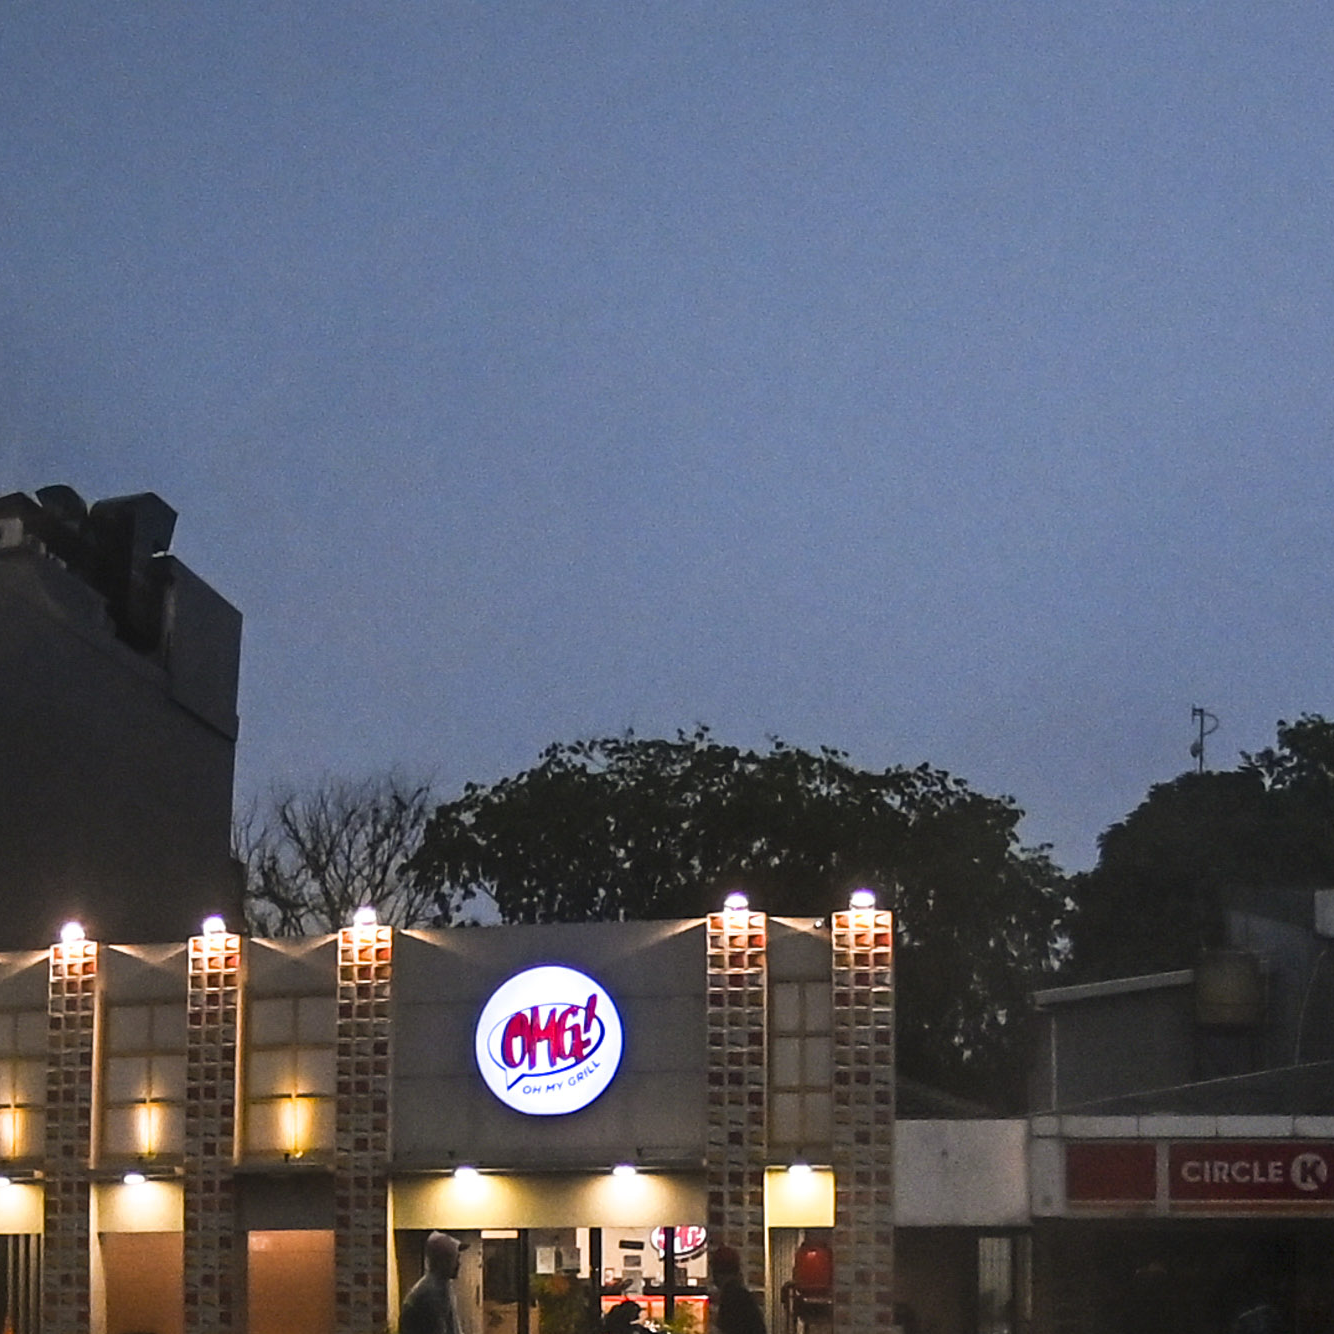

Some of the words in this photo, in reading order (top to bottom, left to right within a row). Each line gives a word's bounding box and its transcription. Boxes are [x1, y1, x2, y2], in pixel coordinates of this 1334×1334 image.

[501, 993, 597, 1071] OMG!
[522, 1085, 542, 1095] OH
[546, 1080, 564, 1093] MY
[568, 1060, 601, 1087] GRILL
[1180, 1160, 1284, 1184] CIRCLE
[1294, 1155, 1328, 1191] K
